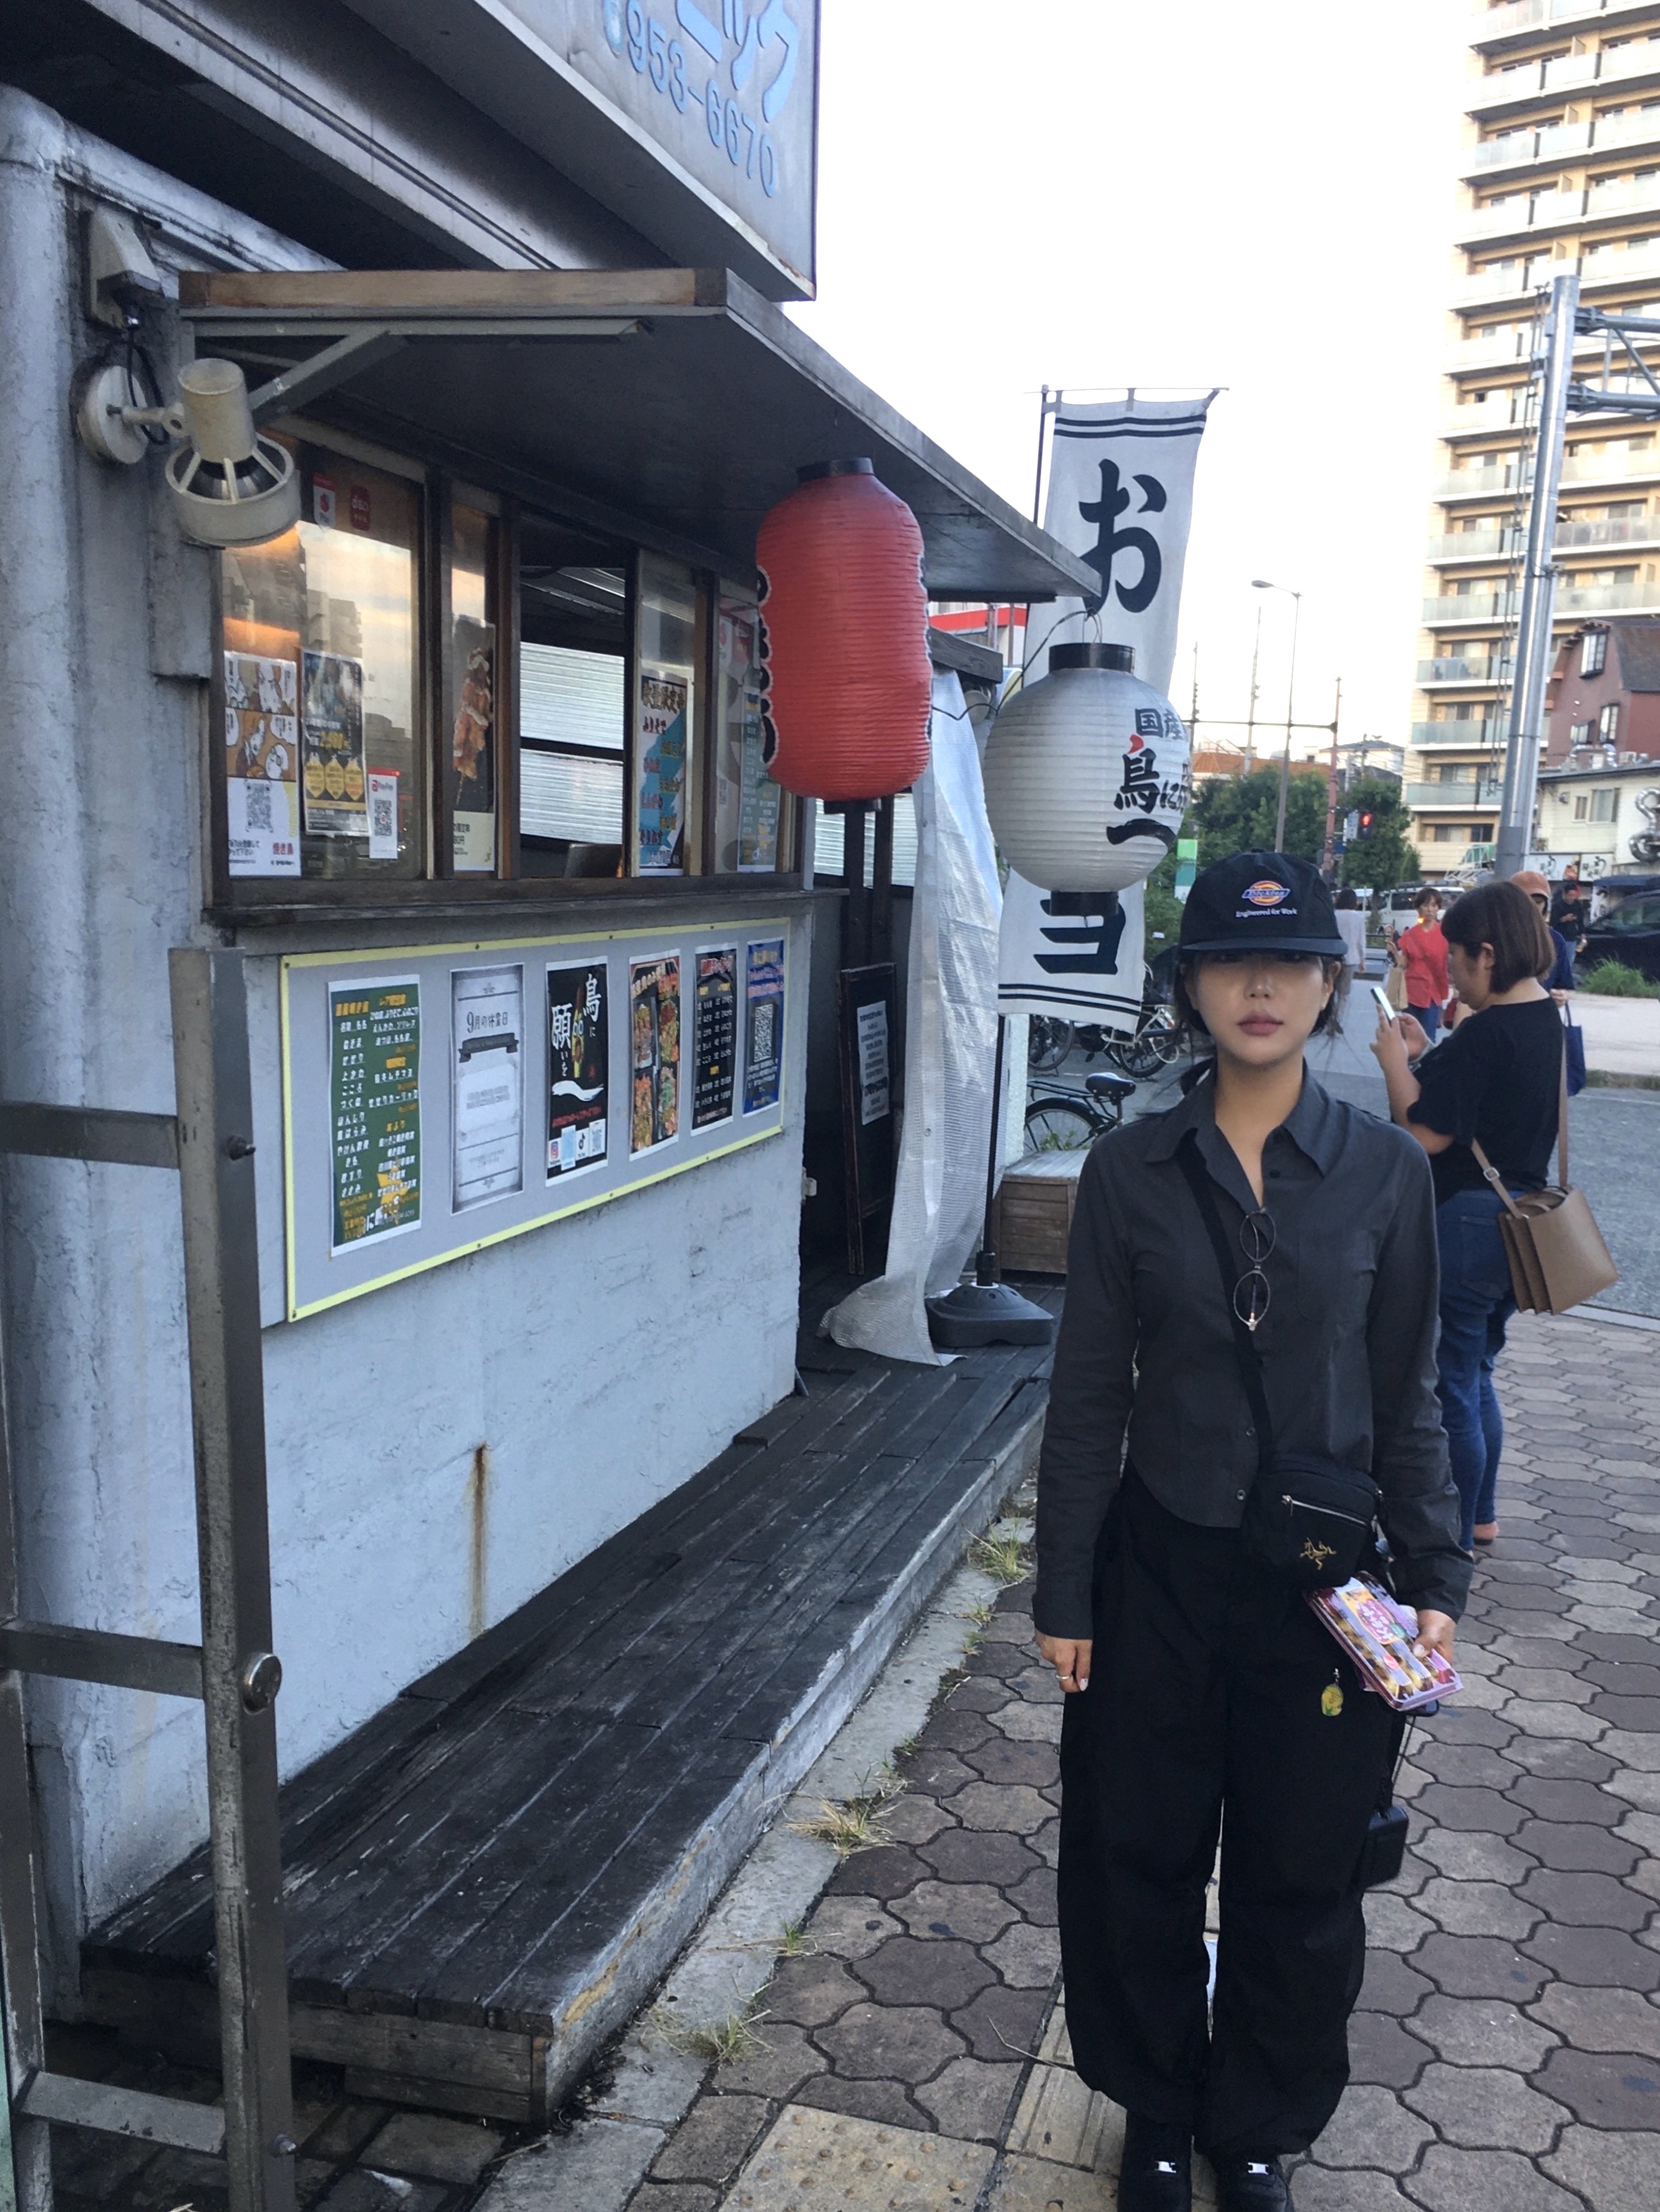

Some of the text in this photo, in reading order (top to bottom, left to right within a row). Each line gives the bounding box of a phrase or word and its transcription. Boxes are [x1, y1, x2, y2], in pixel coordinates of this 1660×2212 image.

[1079, 458, 1167, 618] お
[1135, 708, 1184, 740] 国産
[467, 1011, 508, 1033] 9月の休業日
